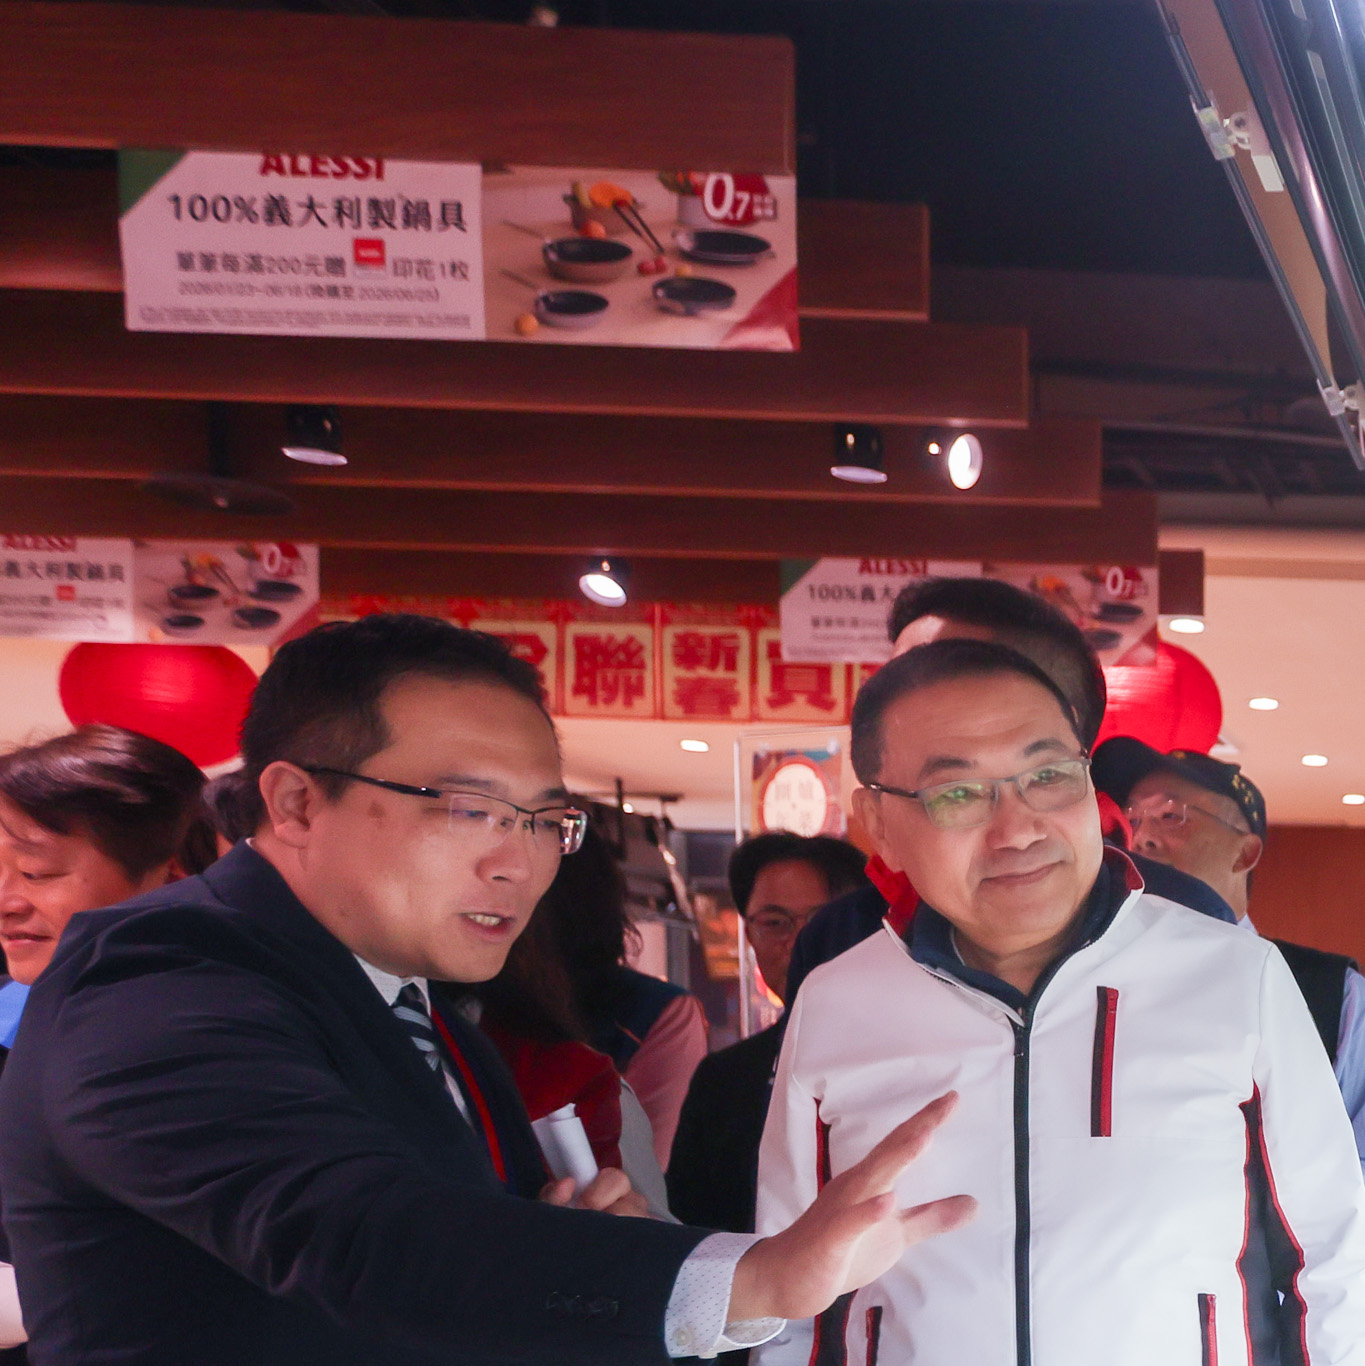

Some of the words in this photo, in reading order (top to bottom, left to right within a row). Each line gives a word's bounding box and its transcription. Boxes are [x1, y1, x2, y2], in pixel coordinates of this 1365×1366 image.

[259, 155, 386, 181] ALESSI
[170, 193, 468, 233] 100%義大利製鍋具
